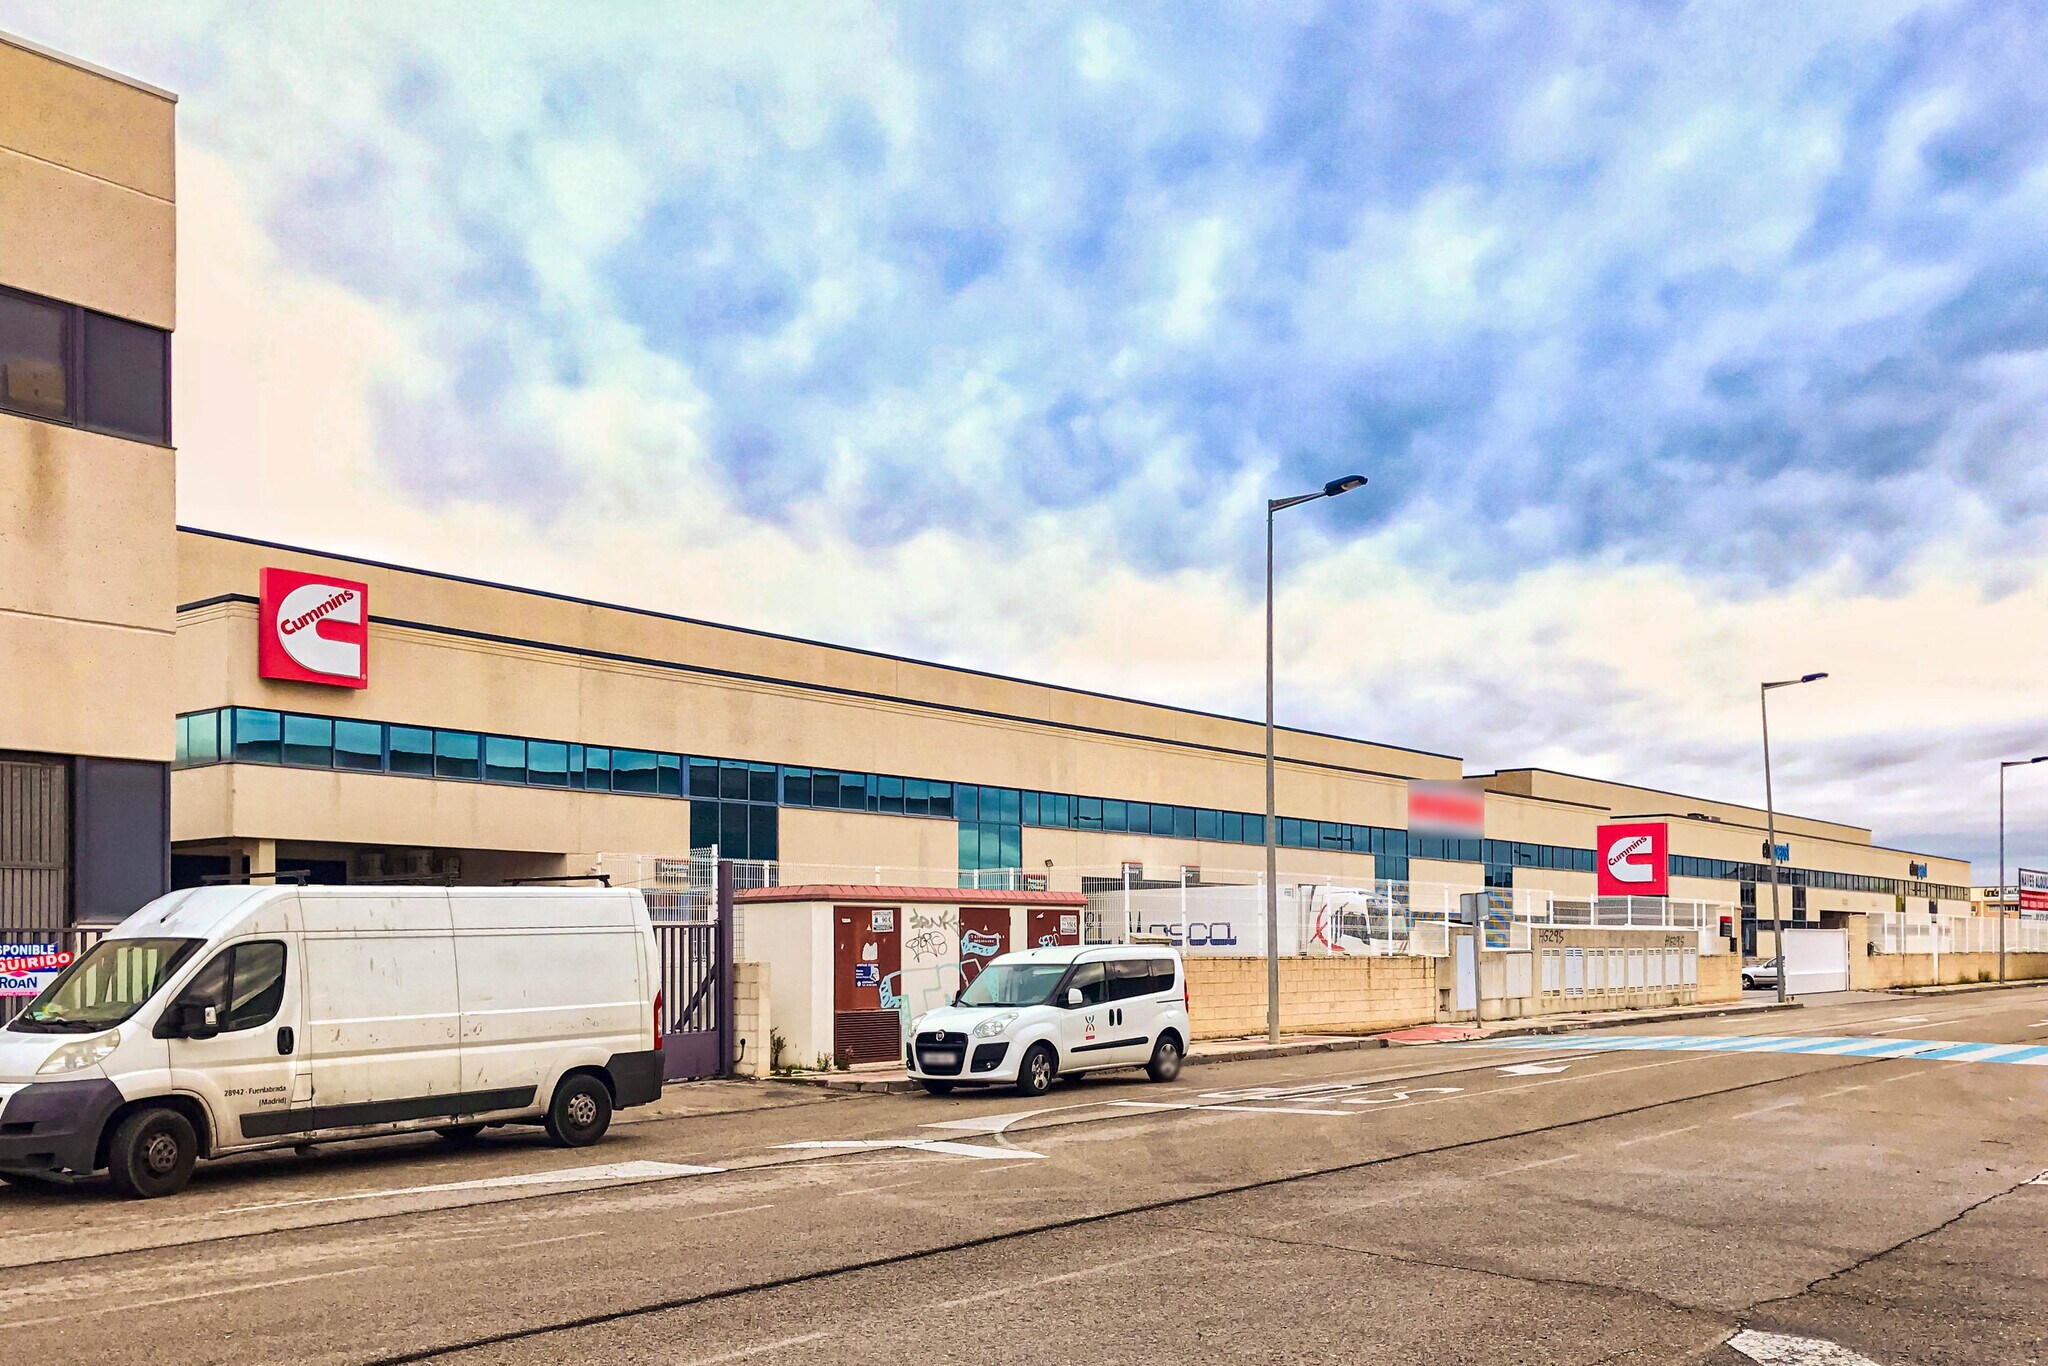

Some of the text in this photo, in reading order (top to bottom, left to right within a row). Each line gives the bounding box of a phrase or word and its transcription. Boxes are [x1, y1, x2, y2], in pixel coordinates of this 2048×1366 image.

[280, 590, 354, 635] Cummins
[1608, 836, 1647, 866] Cummins
[224, 1088, 245, 1097] 28942
[248, 1085, 286, 1095] Fuenlabrada
[258, 1097, 287, 1107] (Madrid)
